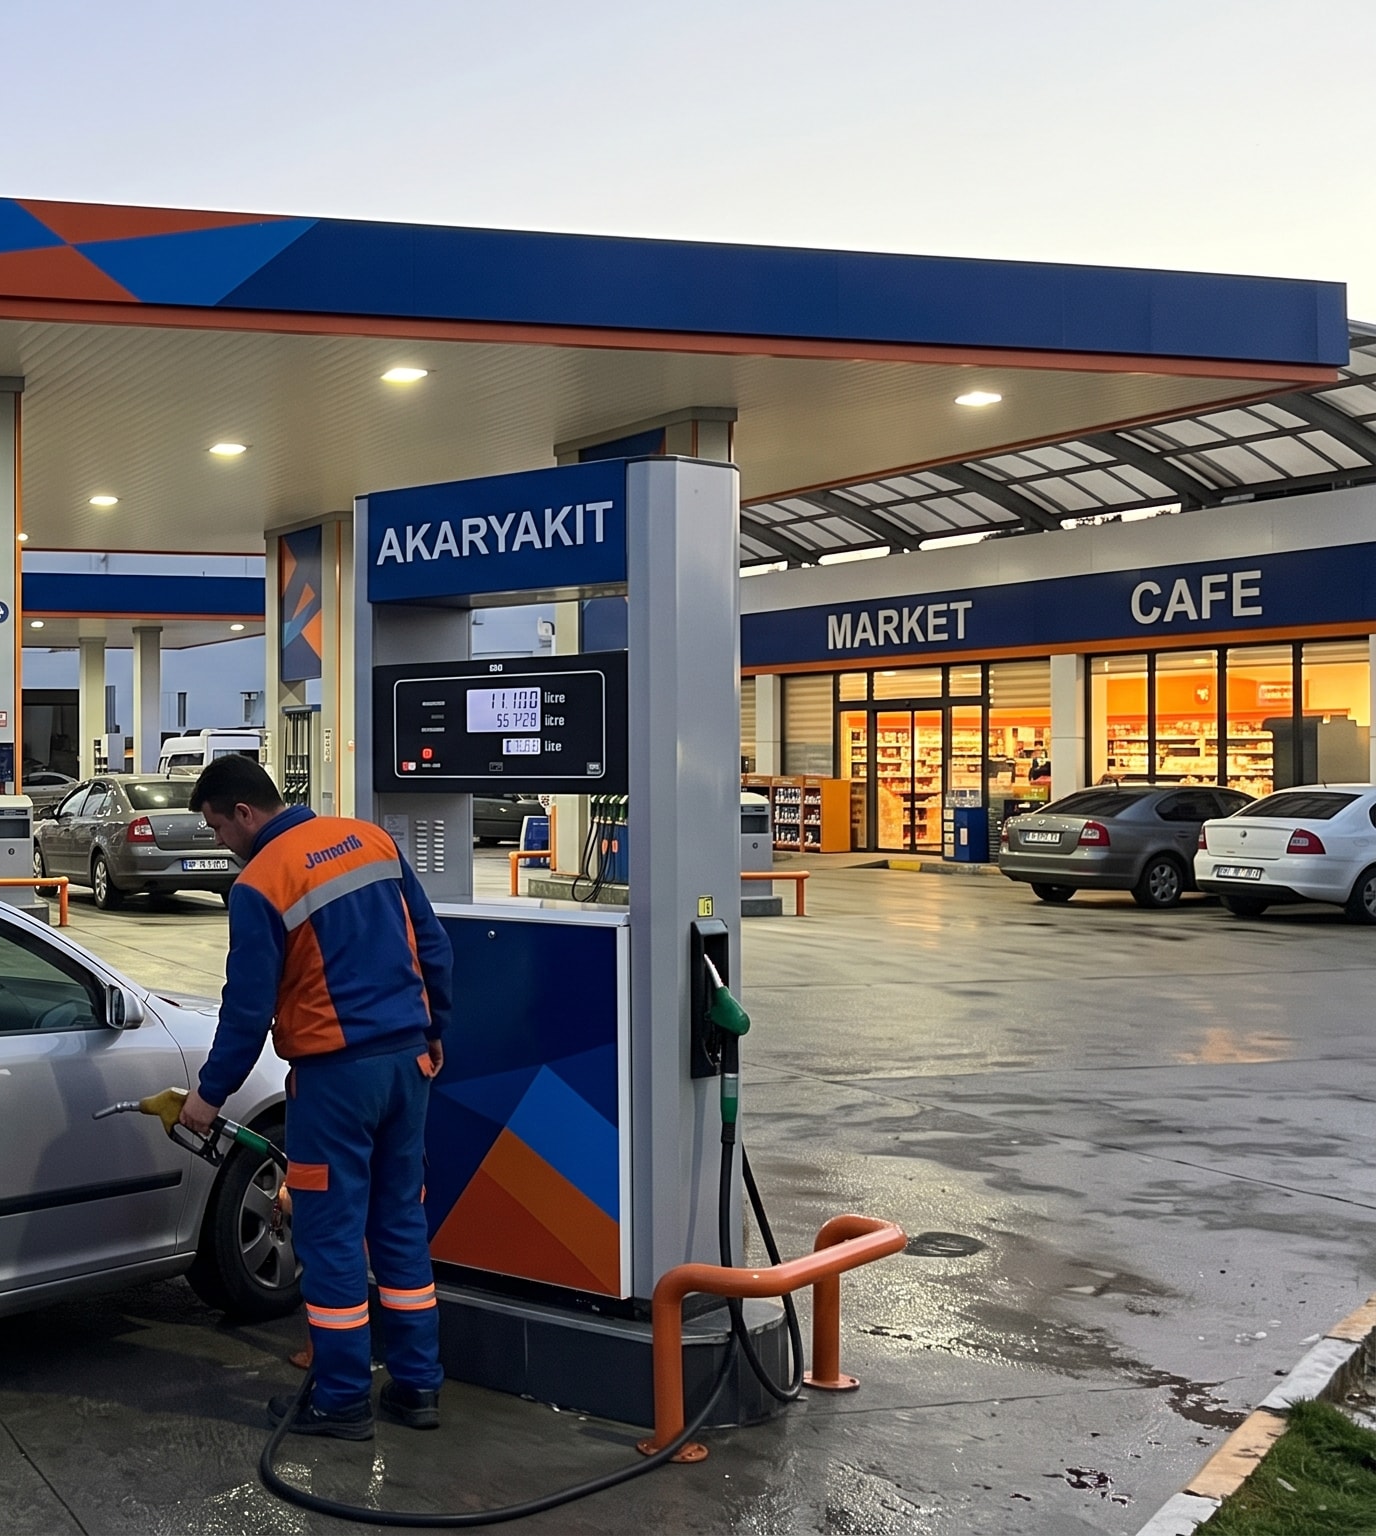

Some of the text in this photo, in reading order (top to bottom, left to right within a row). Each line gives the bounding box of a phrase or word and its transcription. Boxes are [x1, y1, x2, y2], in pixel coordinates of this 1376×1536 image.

[376, 500, 613, 566] AKARYAKIT
[827, 600, 973, 650] MARKET
[1131, 569, 1263, 625] CAFE
